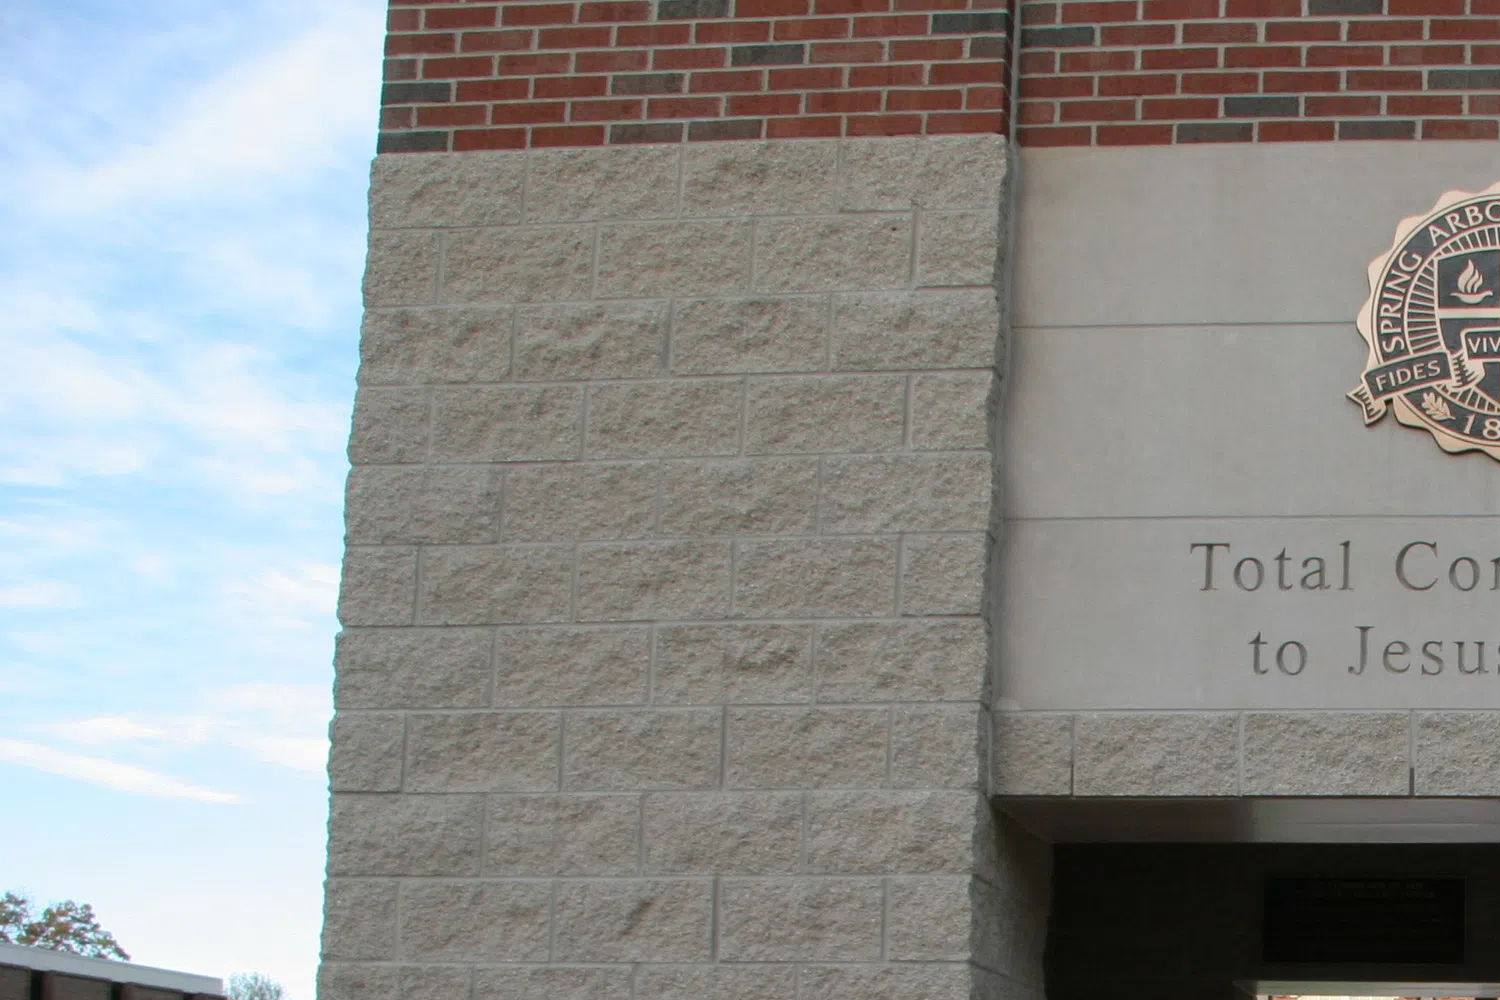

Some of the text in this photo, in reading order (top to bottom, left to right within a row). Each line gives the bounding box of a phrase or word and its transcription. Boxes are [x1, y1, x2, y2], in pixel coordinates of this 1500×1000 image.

[1380, 250, 1423, 353] SPRING
[1375, 359, 1442, 391] FIDES
[1190, 541, 1356, 592] Total
[1249, 630, 1309, 676] to
